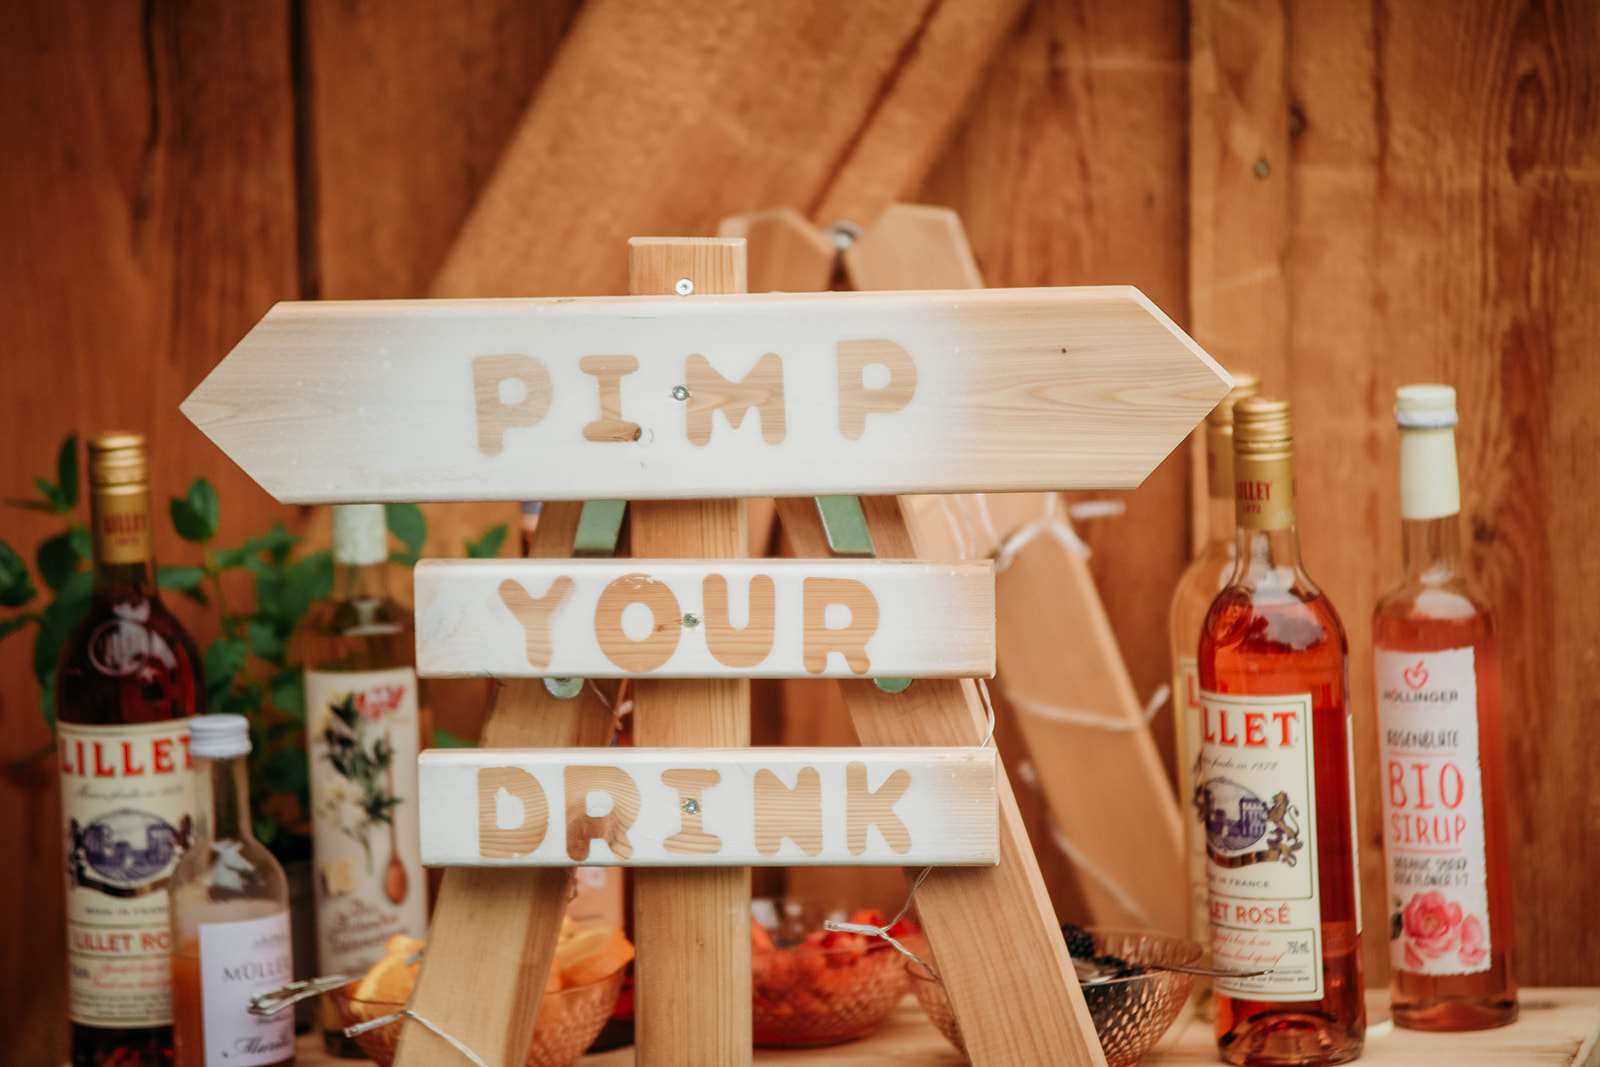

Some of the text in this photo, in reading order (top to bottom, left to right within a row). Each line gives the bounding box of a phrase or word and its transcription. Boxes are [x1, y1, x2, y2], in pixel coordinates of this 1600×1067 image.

[472, 338, 917, 457] PIMP
[498, 573, 880, 675] YOUR
[1388, 761, 1464, 809] BIO
[477, 761, 912, 862] DRINK
[1391, 812, 1466, 844] SIRUP
[1229, 878, 1270, 888] FRANCE
[1236, 902, 1290, 924] ROSÉ
